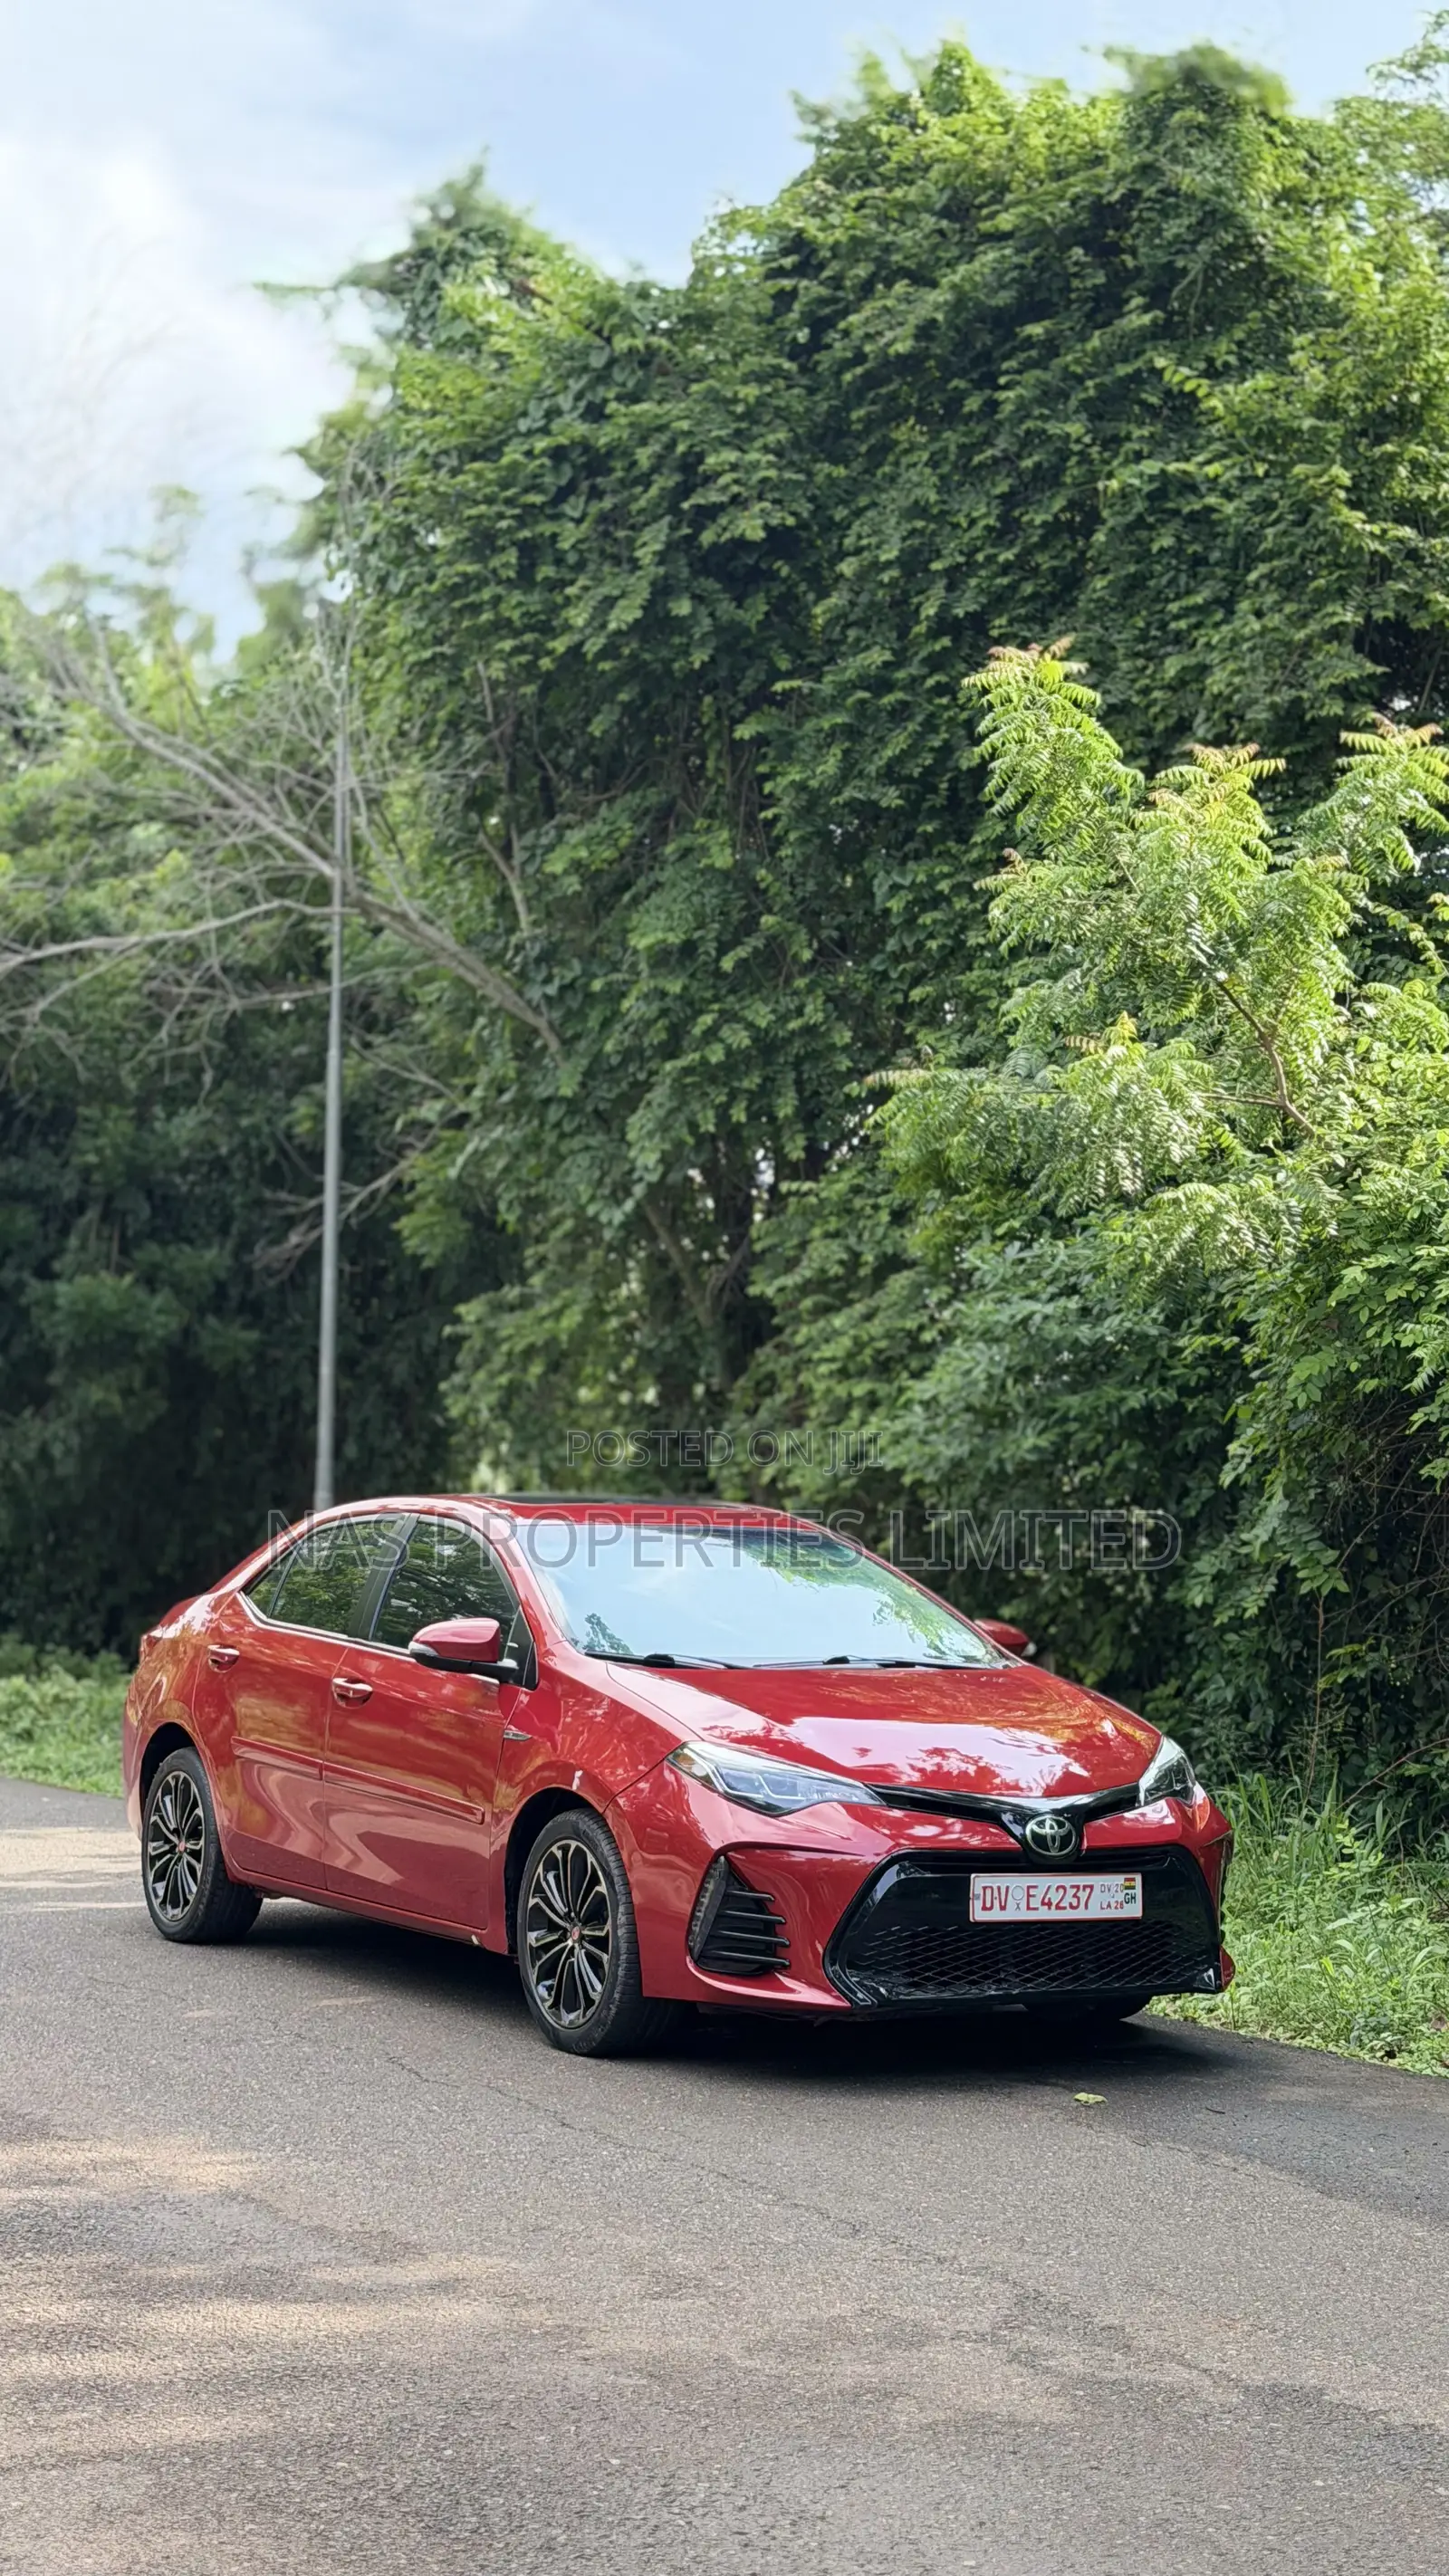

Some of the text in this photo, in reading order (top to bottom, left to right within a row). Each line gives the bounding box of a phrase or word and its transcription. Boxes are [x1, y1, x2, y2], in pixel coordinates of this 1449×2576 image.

[981, 1884, 1094, 1911] DV E4237
[1124, 1892, 1137, 1904] GH
